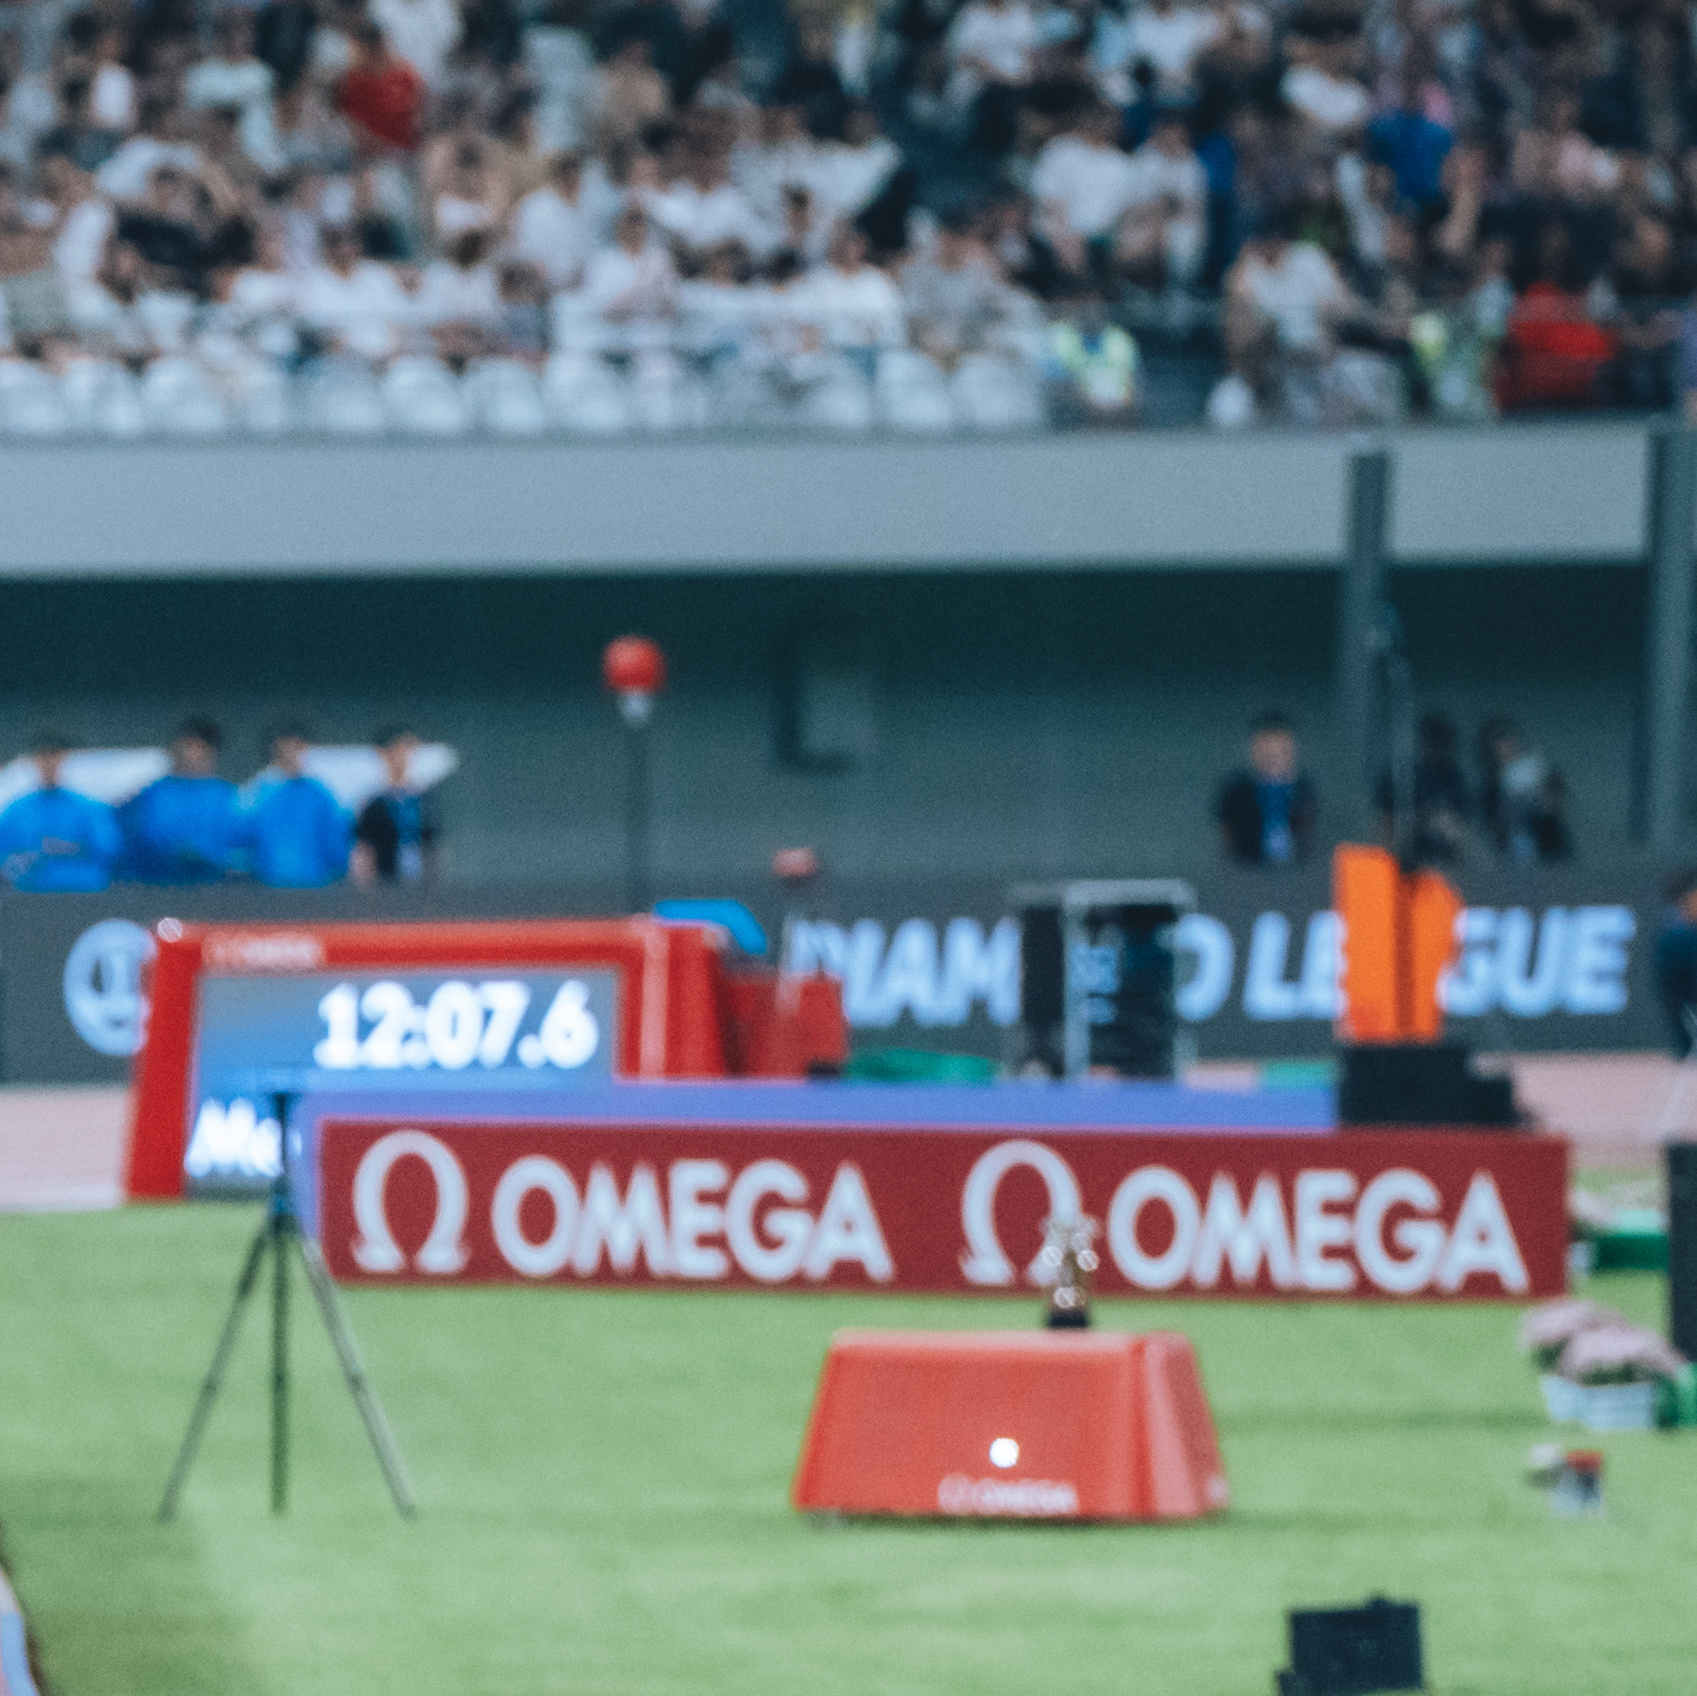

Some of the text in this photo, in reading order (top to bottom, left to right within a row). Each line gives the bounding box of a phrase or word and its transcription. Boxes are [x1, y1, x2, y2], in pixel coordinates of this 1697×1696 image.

[1241, 904, 1639, 1018] LEGUE
[315, 980, 601, 1073] 12:07.6
[491, 1155, 894, 1283] OMEGA
[1106, 1164, 1531, 1295] OMEGA
